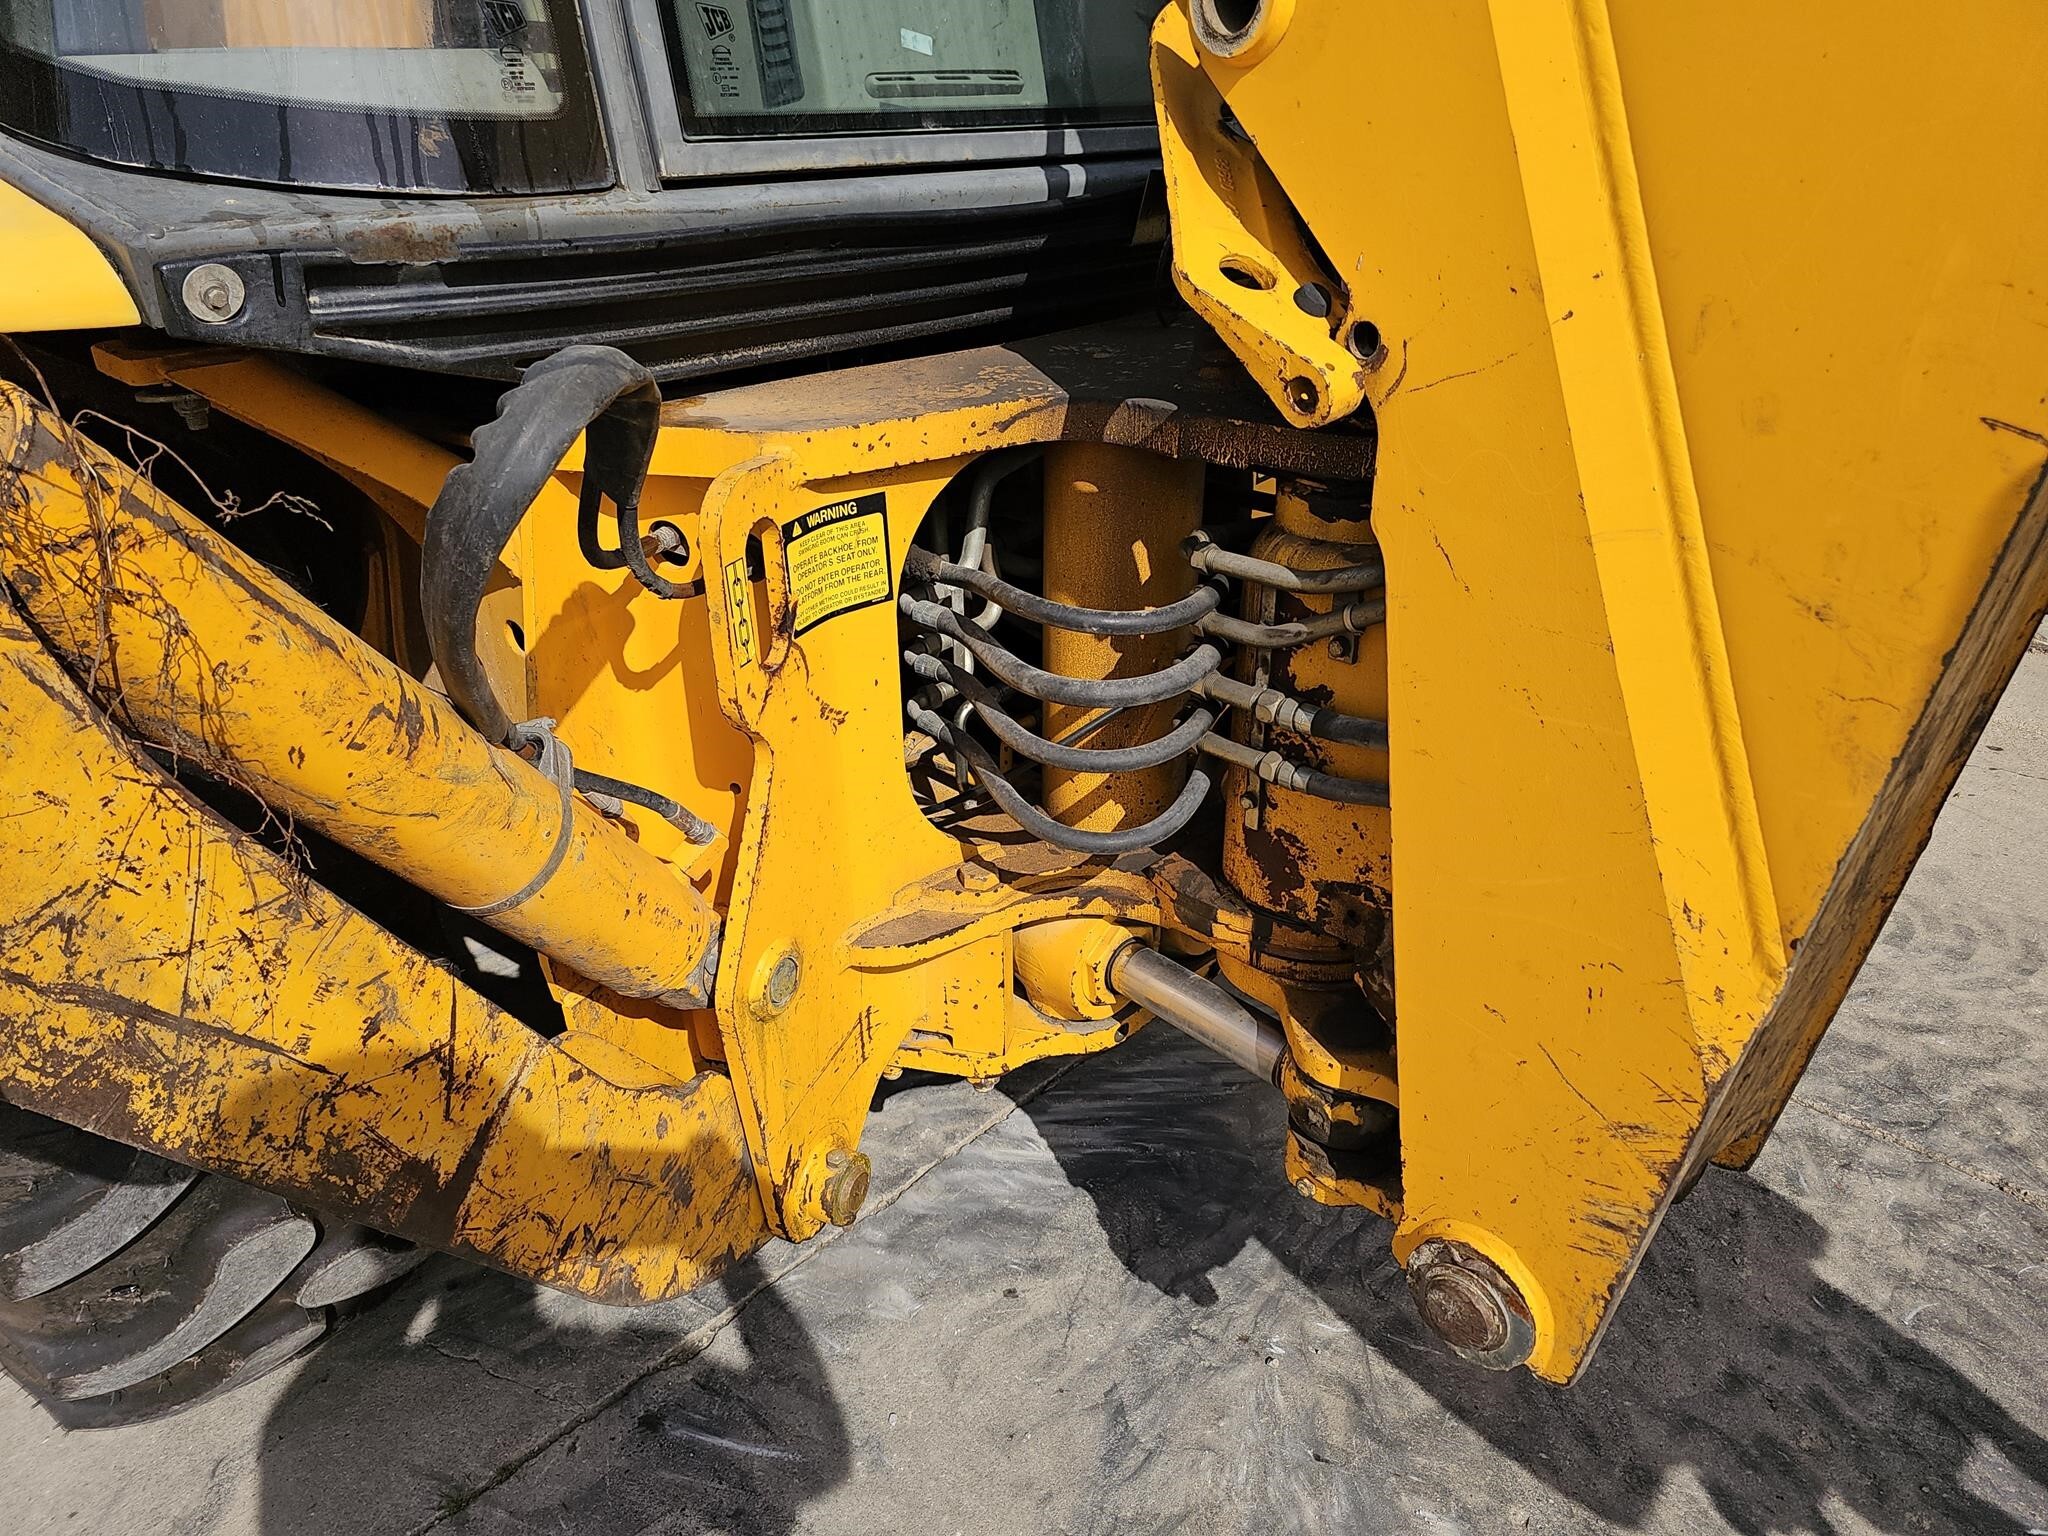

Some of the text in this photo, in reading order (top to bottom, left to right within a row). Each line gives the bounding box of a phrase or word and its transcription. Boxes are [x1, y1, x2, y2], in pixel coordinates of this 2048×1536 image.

[701, 6, 731, 37] JCB
[806, 502, 857, 528] WARNING
[799, 541, 819, 556] SWINGING
[820, 536, 835, 546] BOOM
[837, 532, 848, 540] CAN
[800, 539, 810, 547] KEEP
[810, 533, 825, 543] CLEAR
[793, 554, 817, 573] OPERATE
[857, 536, 878, 547] FROM
[836, 552, 855, 565] SEAT
[857, 547, 878, 558] ONLY.
[796, 559, 880, 596] DO NOT ENTER OPERATOR
[799, 586, 823, 606] ATFORM
[825, 579, 845, 592] FROM
[847, 573, 861, 581] THE
[805, 603, 818, 614] OTHER
[819, 594, 839, 605] METHOD
[840, 588, 858, 597] COULD
[859, 582, 879, 592] RESULT
[818, 600, 842, 614] OPERATOR
